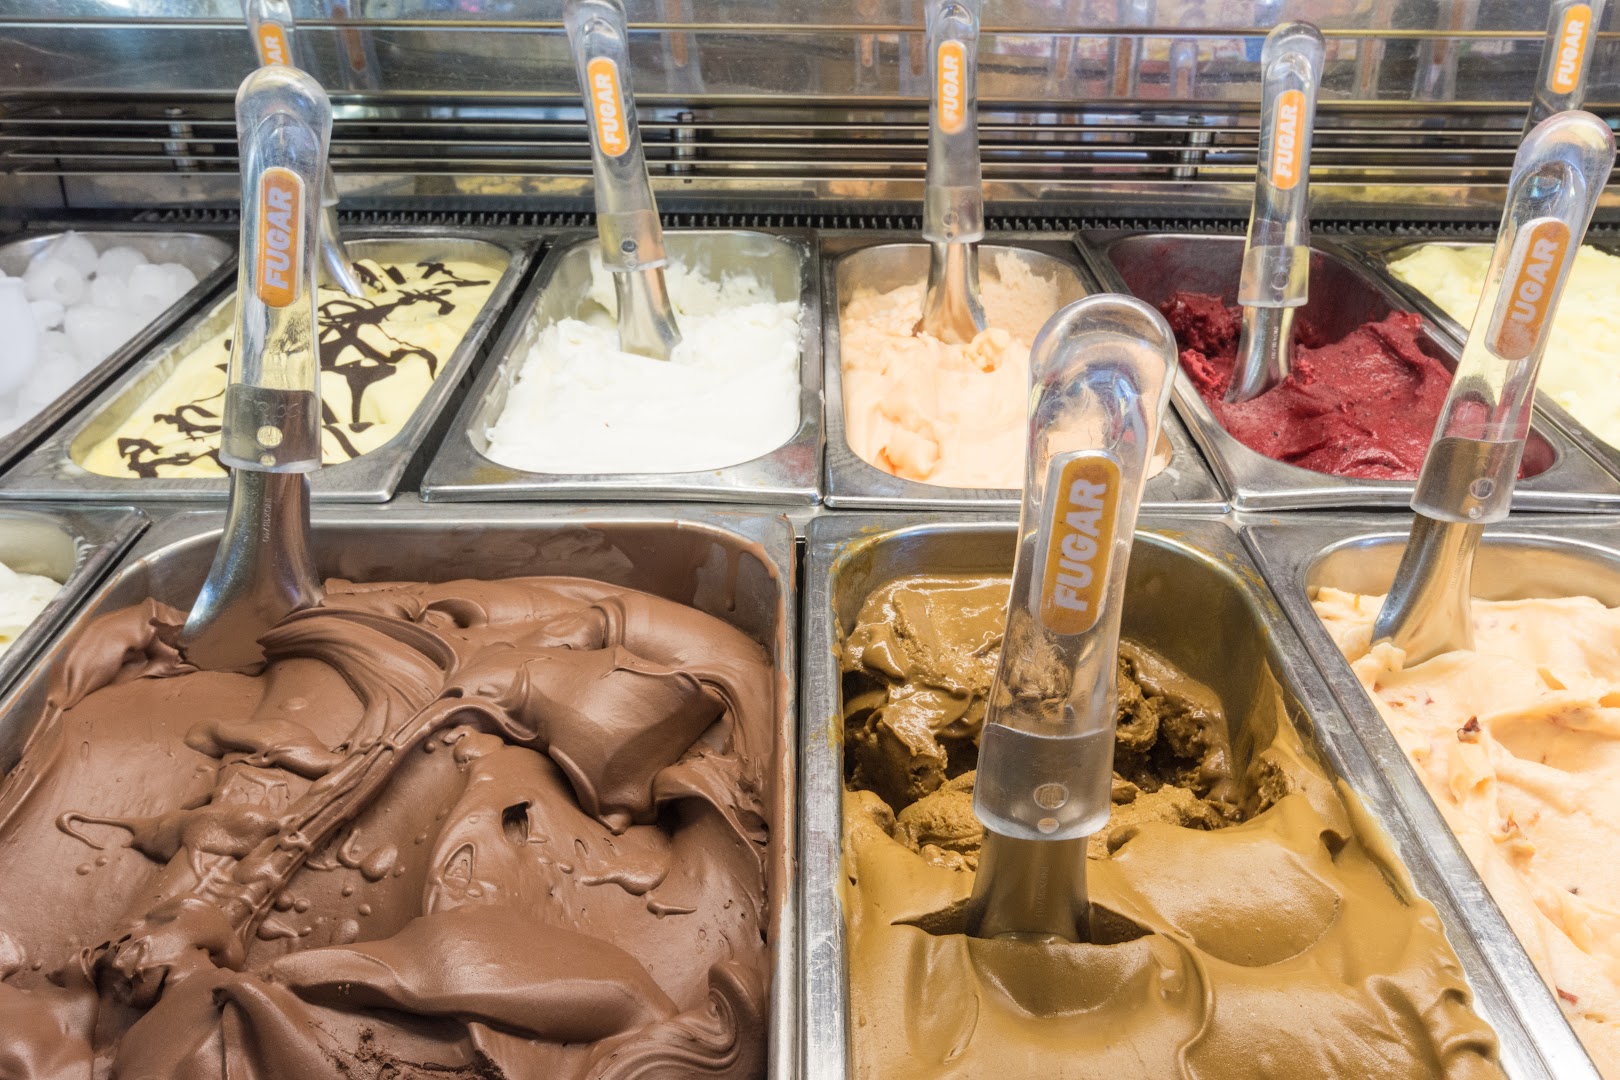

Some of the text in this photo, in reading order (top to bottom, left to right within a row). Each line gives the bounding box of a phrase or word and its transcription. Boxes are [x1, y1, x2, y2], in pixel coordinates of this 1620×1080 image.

[1557, 19, 1585, 86] FUGAR
[594, 73, 621, 145] FUGAR
[1275, 104, 1298, 178] FUGAR
[265, 186, 293, 291] FUGAR
[1055, 478, 1106, 612] FUGAR
